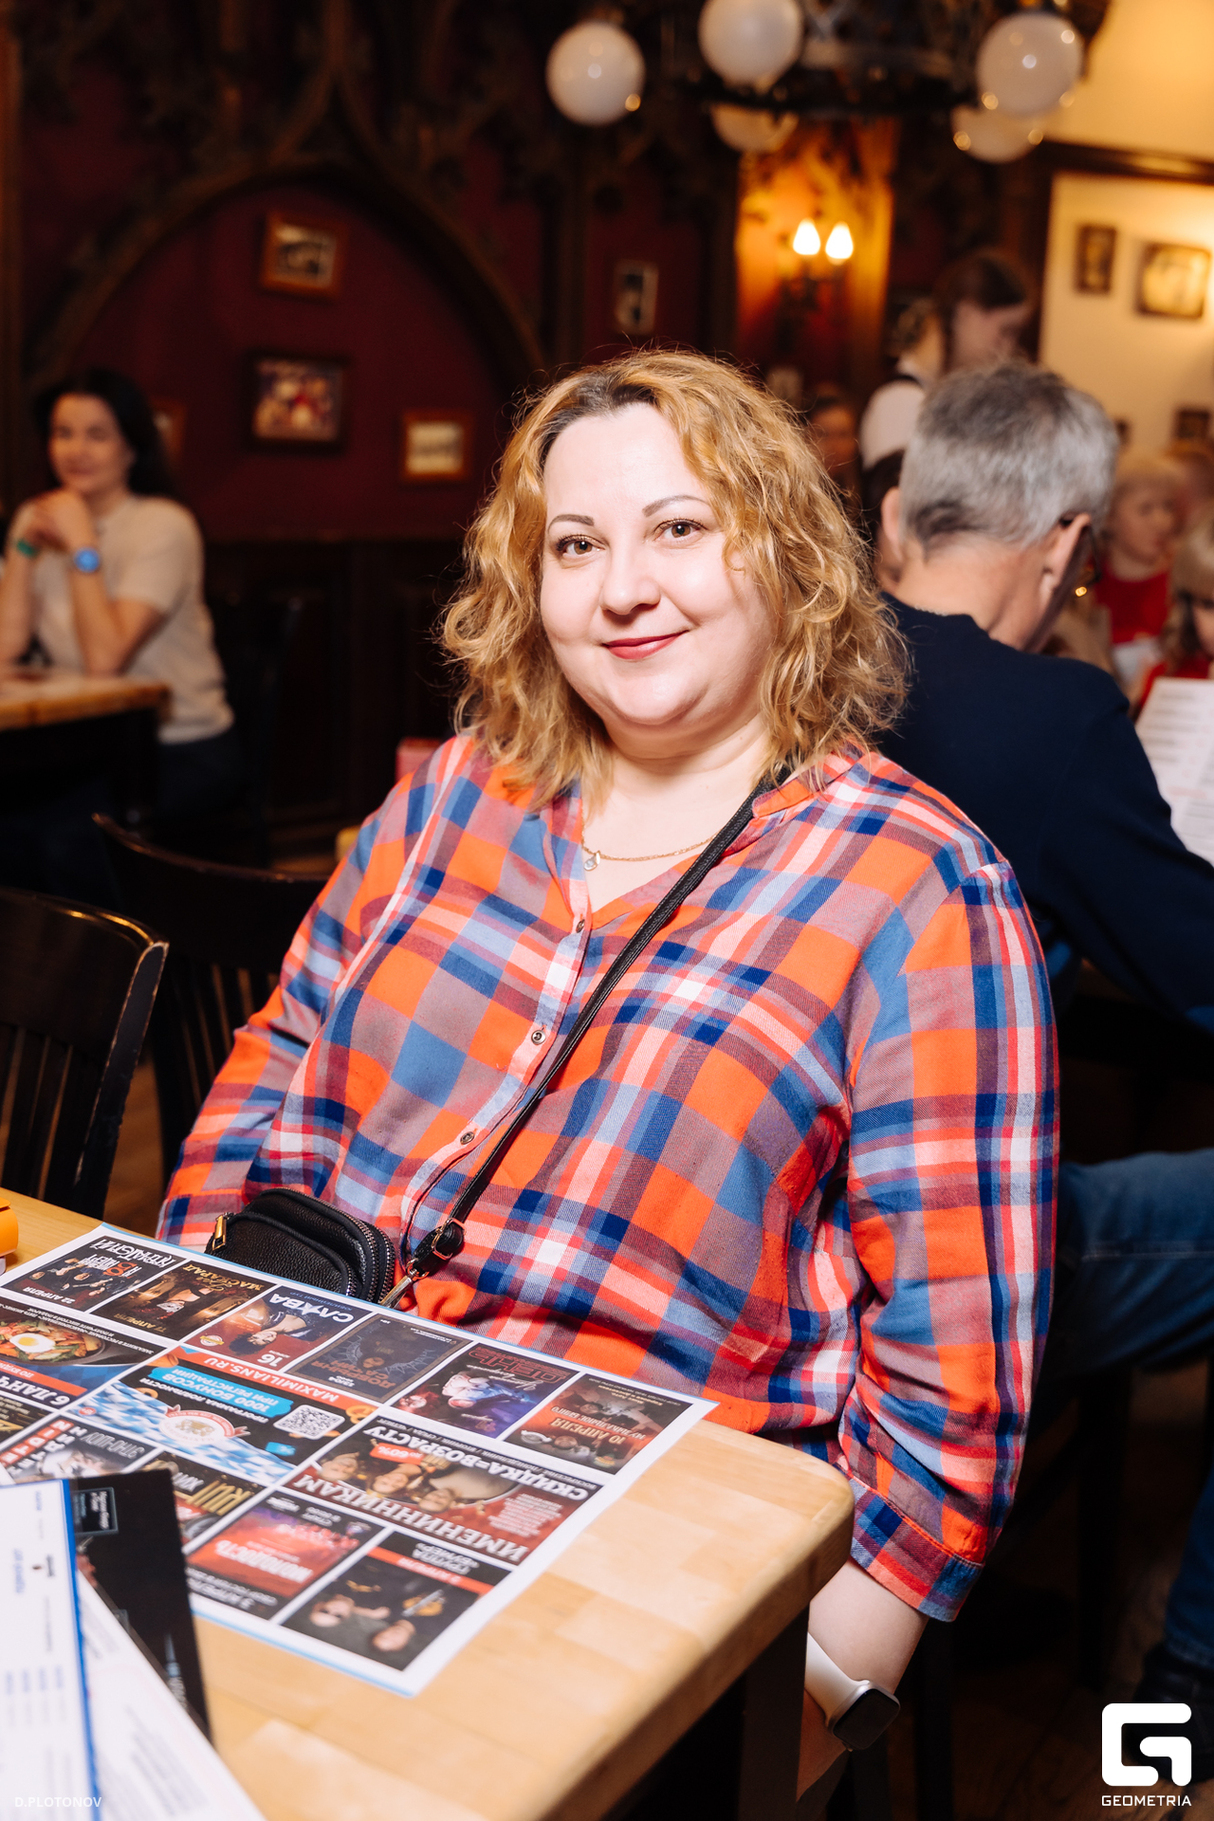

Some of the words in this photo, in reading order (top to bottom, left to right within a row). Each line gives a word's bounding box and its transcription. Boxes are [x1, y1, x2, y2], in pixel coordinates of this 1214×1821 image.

[183, 1265, 262, 1290] МАСКАРАД
[23, 1287, 63, 1300] АПРЕЛЯ
[115, 1314, 156, 1328] АПРЕЛЯ
[257, 1354, 283, 1366] 16
[469, 1350, 565, 1383] ДЕНЬ
[172, 1369, 252, 1397] РЕГИСТРАЦИИ
[205, 1356, 338, 1402] MAXIMILIANS.RU
[312, 1361, 395, 1388] ДОБРЫНЯ
[140, 1378, 206, 1401] ЛОЯЛЬНОСТИ
[163, 1374, 234, 1400] БОНУСОВ
[49, 1395, 70, 1406] 6
[206, 1399, 269, 1423] ПРОГРАММА
[234, 1397, 269, 1412] 1000
[252, 1394, 278, 1406] ПРИ
[548, 1405, 580, 1419] БИНГО
[551, 1418, 609, 1439] АПРЕЛЯ
[575, 1416, 647, 1441] МУЗЫКАЛЬНОЕ
[608, 1435, 625, 1444] 10
[81, 1432, 144, 1458] ЭТНО-ШОУ
[378, 1446, 411, 1458] 60%
[366, 1427, 586, 1499] СКИДКА=ВОЗРАСТУ
[296, 1476, 526, 1559] ИМЕНИННИКАМ
[216, 1541, 311, 1581] МОЛОДОСТЬ
[398, 1558, 451, 1580] АПРЕЛЯ
[413, 1550, 469, 1574] ГРУППА
